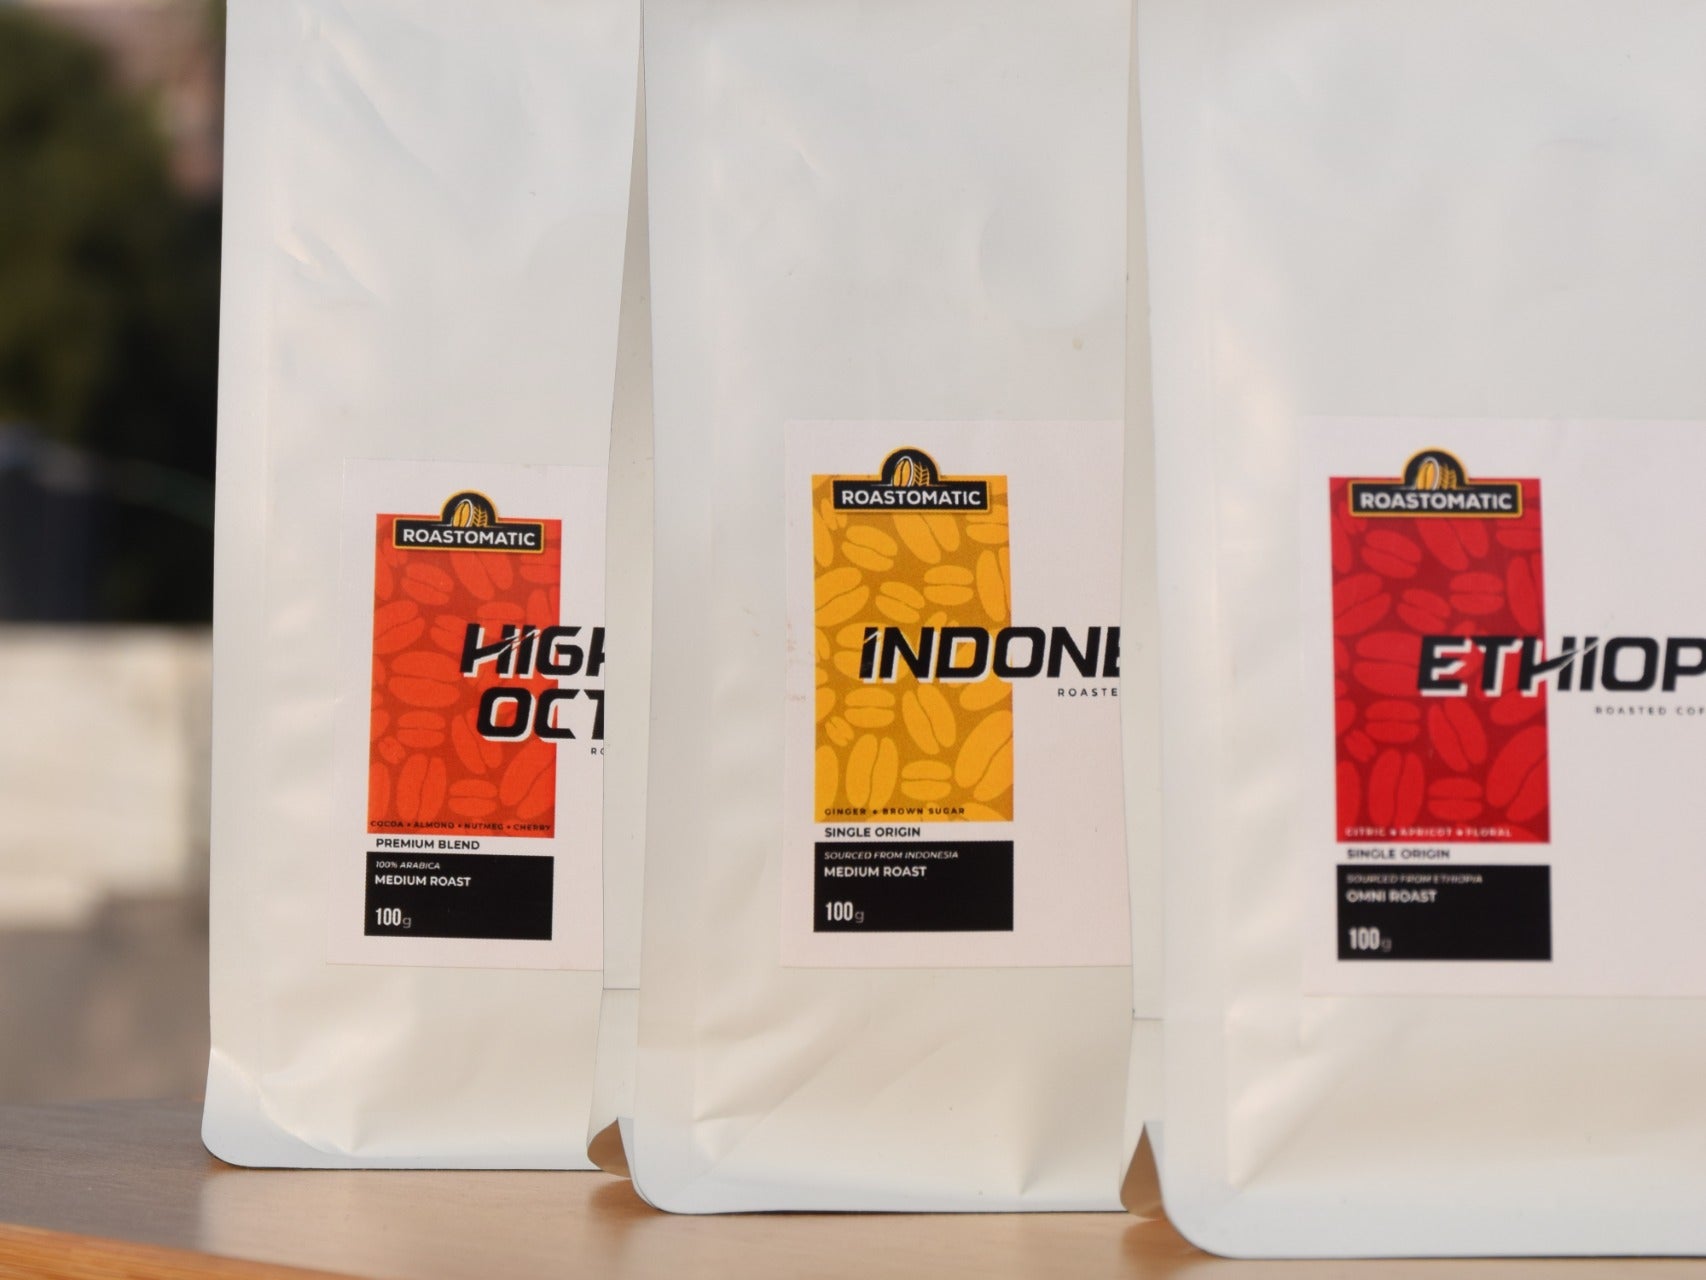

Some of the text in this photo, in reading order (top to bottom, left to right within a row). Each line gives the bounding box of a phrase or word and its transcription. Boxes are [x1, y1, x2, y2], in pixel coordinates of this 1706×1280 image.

[841, 489, 981, 505] ROASTOMATIC
[1360, 491, 1513, 510] ROASTOMATIC
[403, 528, 536, 547] ROASTOMATIC
[1417, 635, 1706, 695] ETHIOP
[1057, 687, 1118, 697] ROASTE
[1595, 706, 1667, 716] ROASTED
[824, 806, 966, 817] GINGER BROWN SUGAR
[370, 819, 551, 832] COCOA ALMOND NUTMEG CHERRY
[824, 826, 921, 838] SINGLE ORIGIN
[1345, 826, 1512, 838] CITRIC APRICOT FLORAL
[375, 837, 480, 851] PREMIUM BLEND
[824, 850, 959, 860] SOURCED FROM INDONESIA
[1346, 848, 1451, 860] SINGLE ORIGIN
[375, 860, 441, 870] 100% ARABICA
[824, 865, 927, 878] MEDIUM ROAST
[374, 874, 472, 888] MEDIUM ROAST
[1346, 873, 1398, 885] SOURCED
[1433, 873, 1483, 885] ETHIOPIA
[1345, 889, 1438, 904] OMNI ROAST
[375, 907, 412, 929] 100g
[825, 900, 865, 923] 100g
